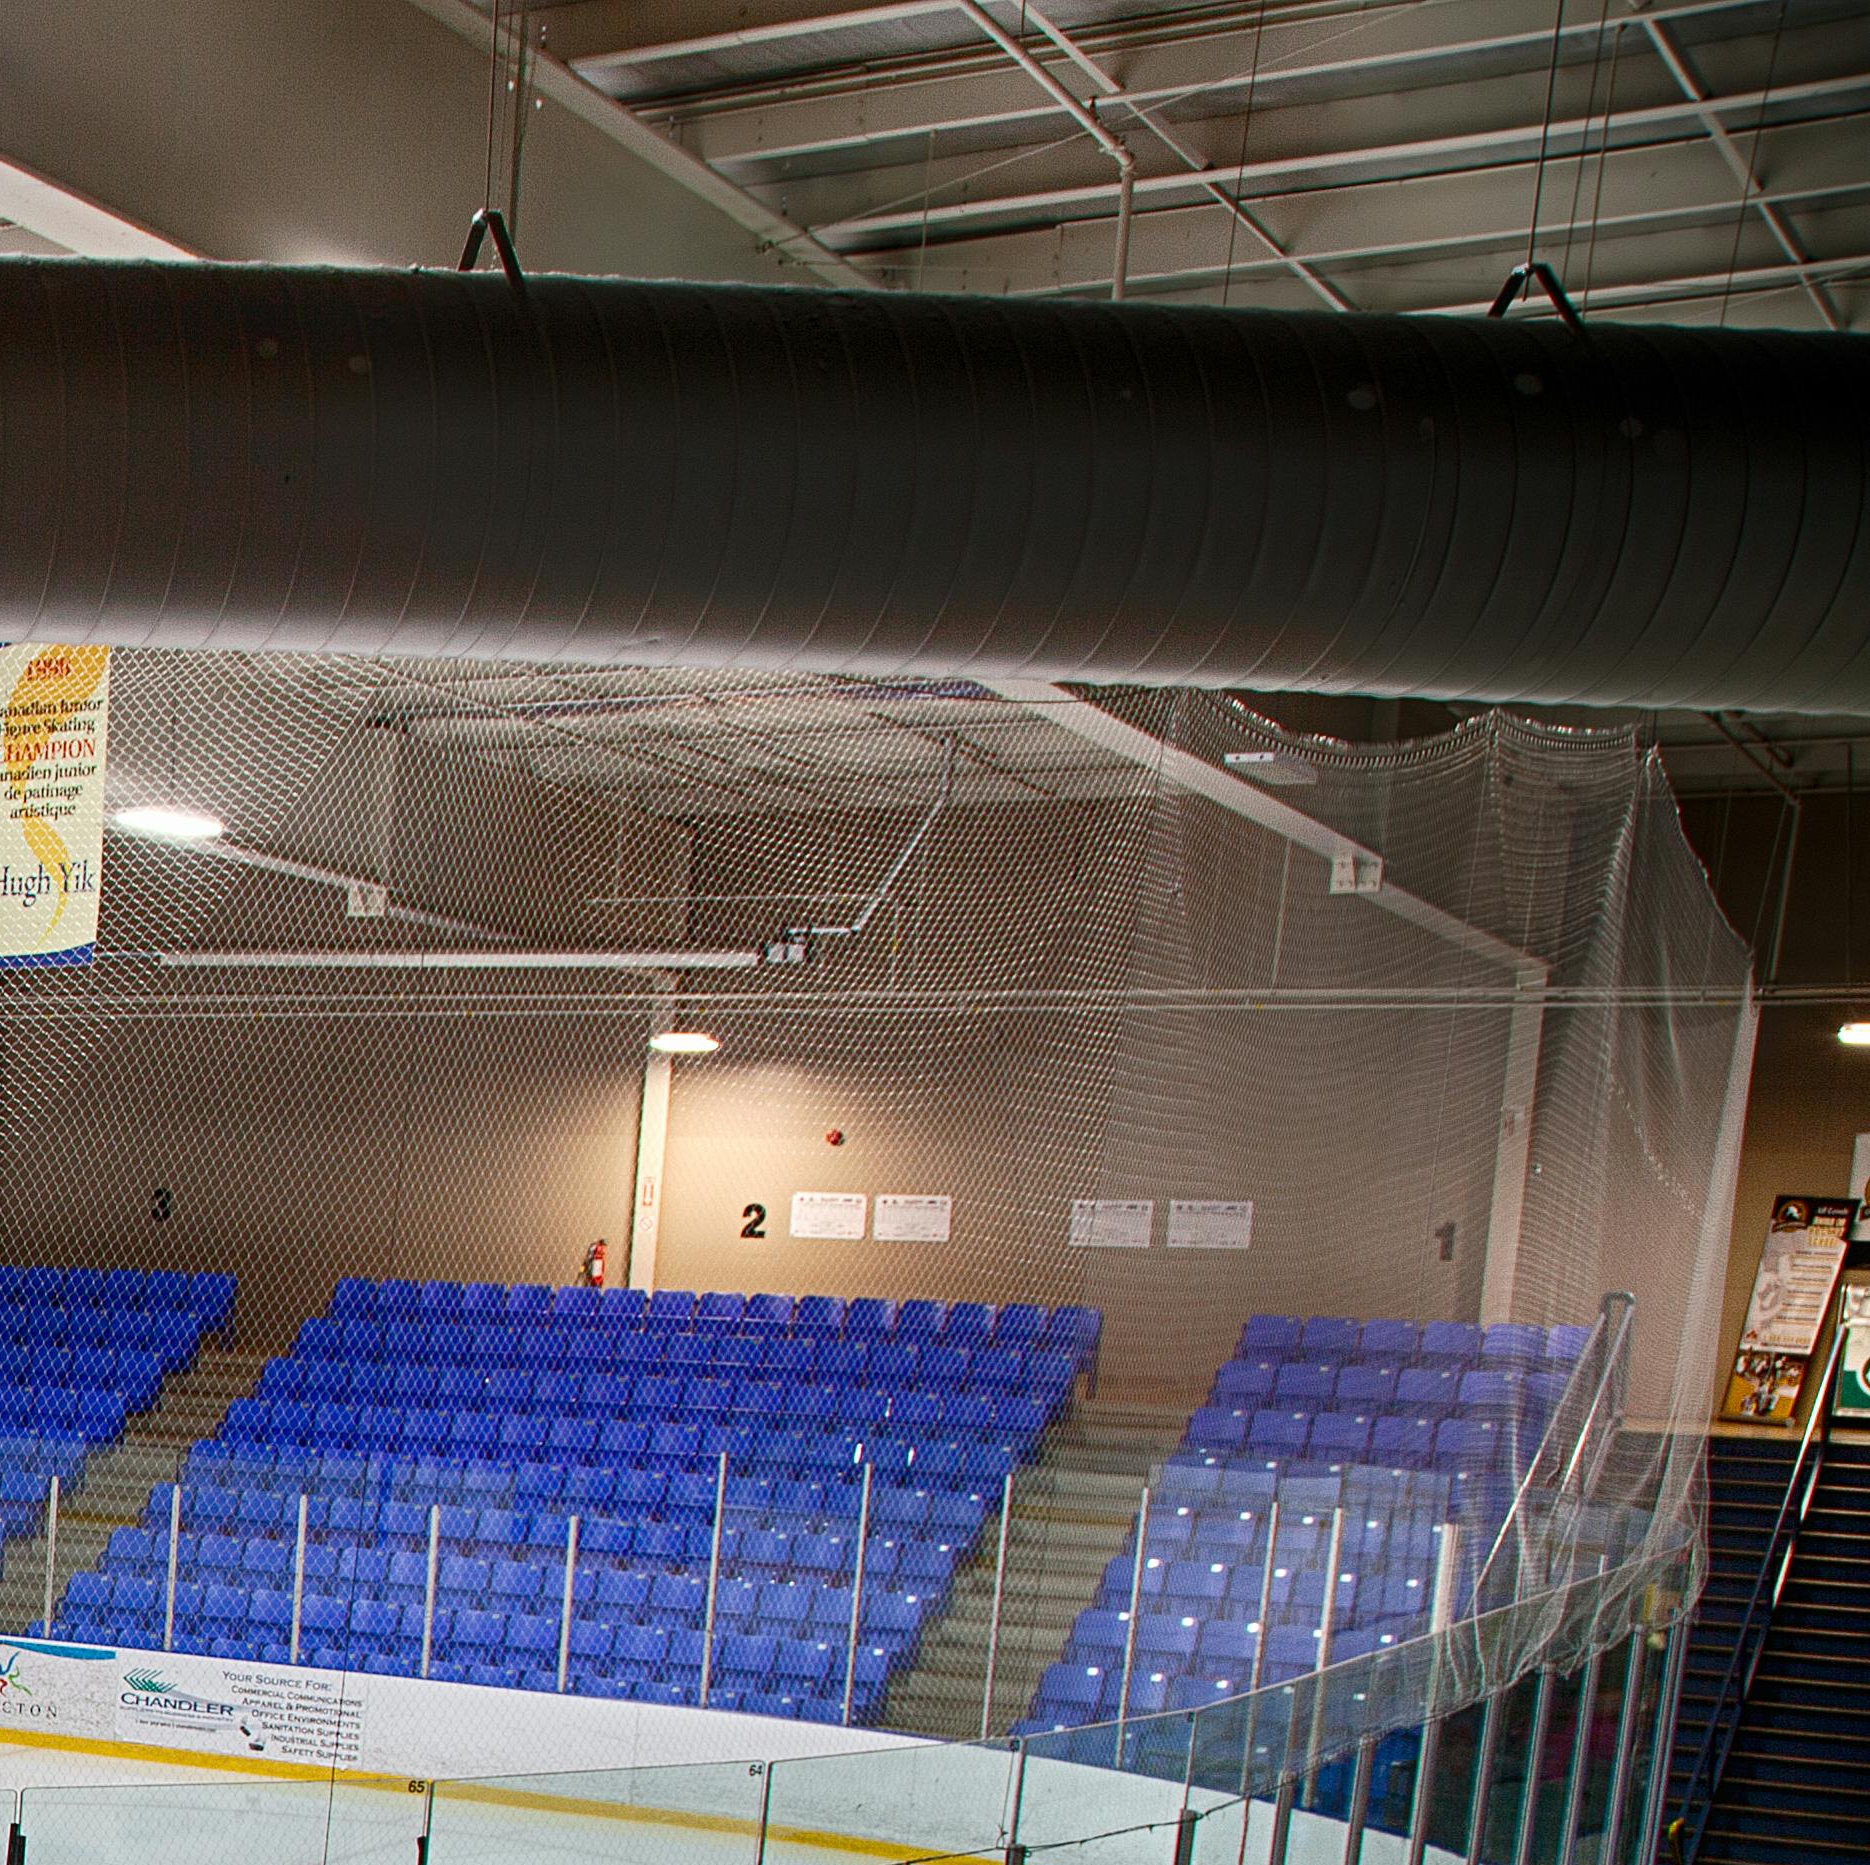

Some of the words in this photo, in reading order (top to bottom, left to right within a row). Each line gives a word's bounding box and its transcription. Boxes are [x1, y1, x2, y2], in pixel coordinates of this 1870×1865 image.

[44, 718, 96, 735] Skating
[54, 762, 98, 782] junior
[4, 785, 21, 801] de
[23, 783, 84, 804] patinage
[10, 803, 77, 821] artistique
[58, 858, 96, 893] Yik
[154, 1187, 171, 1221] 3
[740, 1202, 767, 1239] 2
[1434, 1222, 1456, 1262] 1
[222, 1670, 253, 1684] YOUR
[255, 1674, 303, 1689] SOURCE
[305, 1679, 332, 1692] FOR:
[121, 1692, 235, 1717] CHANDLER
[231, 1685, 285, 1699] COMMERCIAL
[287, 1691, 363, 1707] COMMUNICATIONS
[242, 1697, 283, 1711] APPAREL
[295, 1704, 361, 1719] PROMOTIONAL
[251, 1709, 285, 1721] OFFICE
[287, 1713, 361, 1730] ENVIRONMENTS
[261, 1721, 314, 1735] SANITATION
[316, 1727, 360, 1741] SUPPLIES
[270, 1733, 317, 1747] INDUSTRIAL
[281, 1745, 314, 1757] SAFETY
[748, 1764, 763, 1777] 64
[407, 1780, 426, 1794] 65
